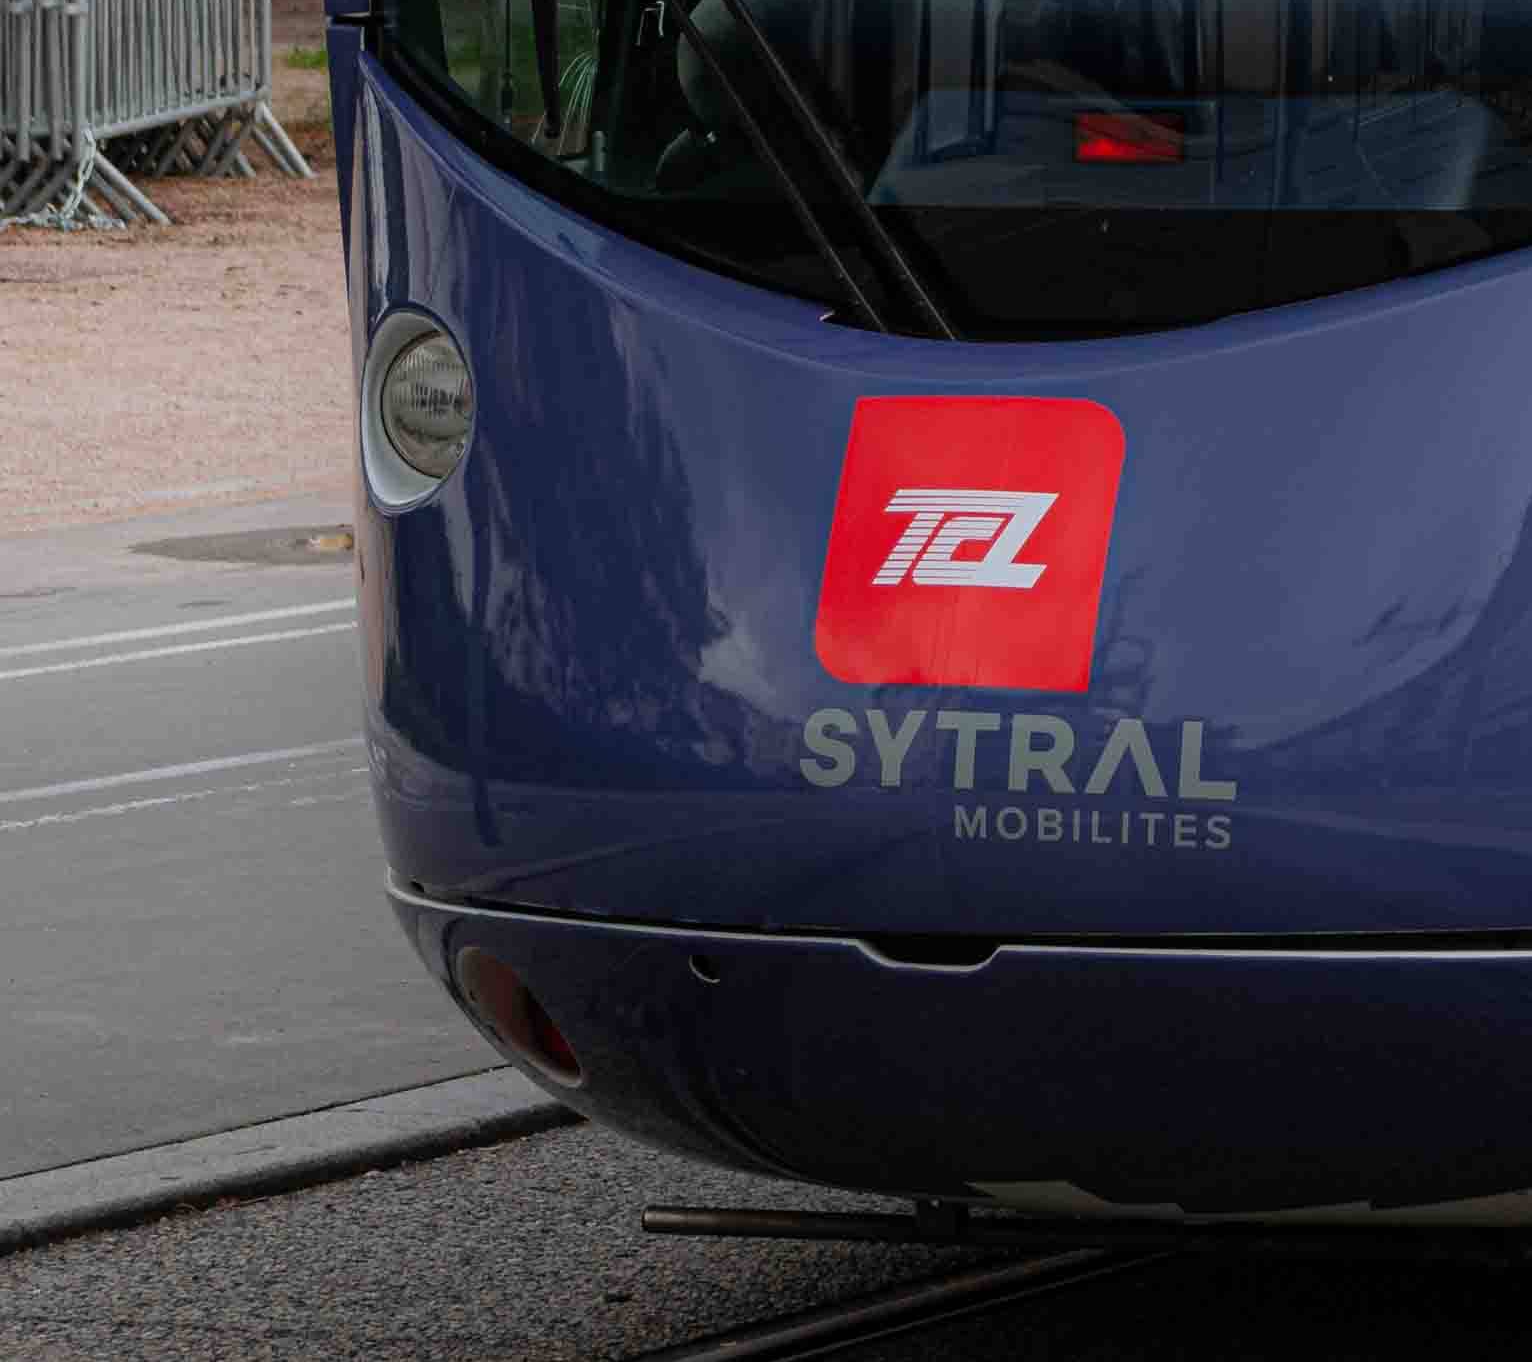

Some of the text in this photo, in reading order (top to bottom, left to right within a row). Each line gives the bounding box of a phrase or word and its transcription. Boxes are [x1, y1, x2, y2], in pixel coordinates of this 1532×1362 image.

[872, 488, 1059, 589] TCL
[800, 707, 1238, 801] SYTRAL
[953, 805, 1232, 849] MOBILITES
